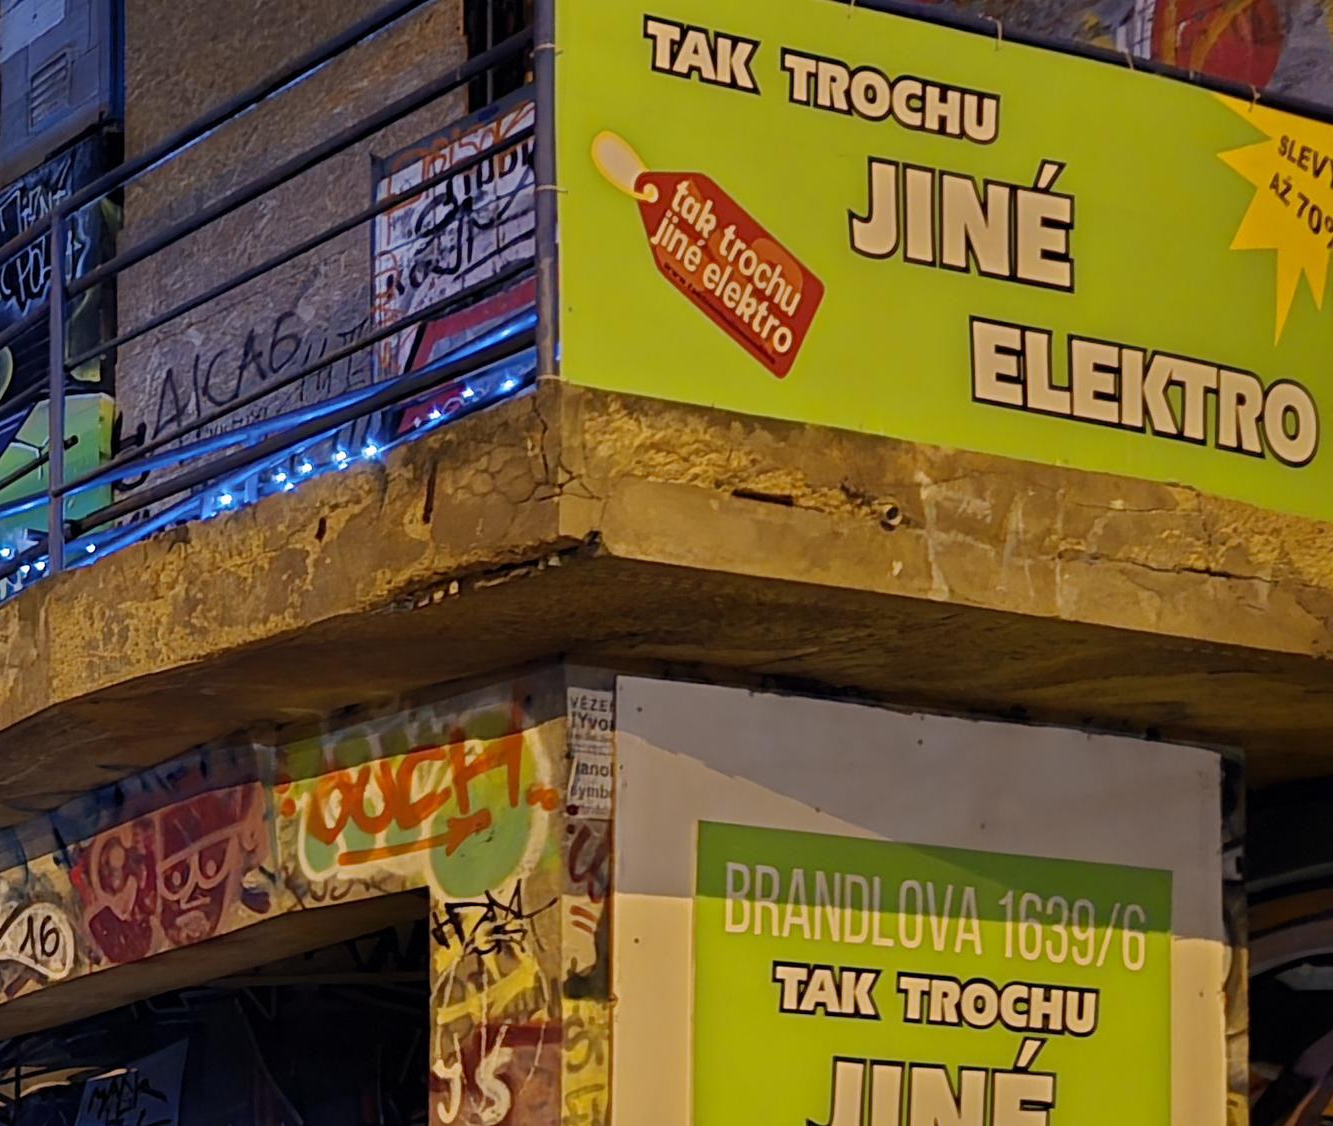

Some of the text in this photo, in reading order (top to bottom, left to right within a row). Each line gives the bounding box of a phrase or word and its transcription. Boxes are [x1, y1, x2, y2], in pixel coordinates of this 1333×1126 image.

[644, 14, 1001, 144] TAK TROCHU
[671, 180, 717, 239] tak
[719, 225, 801, 317] trochu
[848, 157, 1075, 293] JINÉ
[1269, 171, 1293, 207] AŽ
[650, 209, 706, 272] jiné
[702, 263, 793, 353] elektro
[969, 314, 1318, 468] ELEKTRO
[19, 914, 60, 957] 16
[724, 861, 1148, 971] BRANDLOVA 1639/6
[772, 960, 1099, 1037] TAK TROCHU
